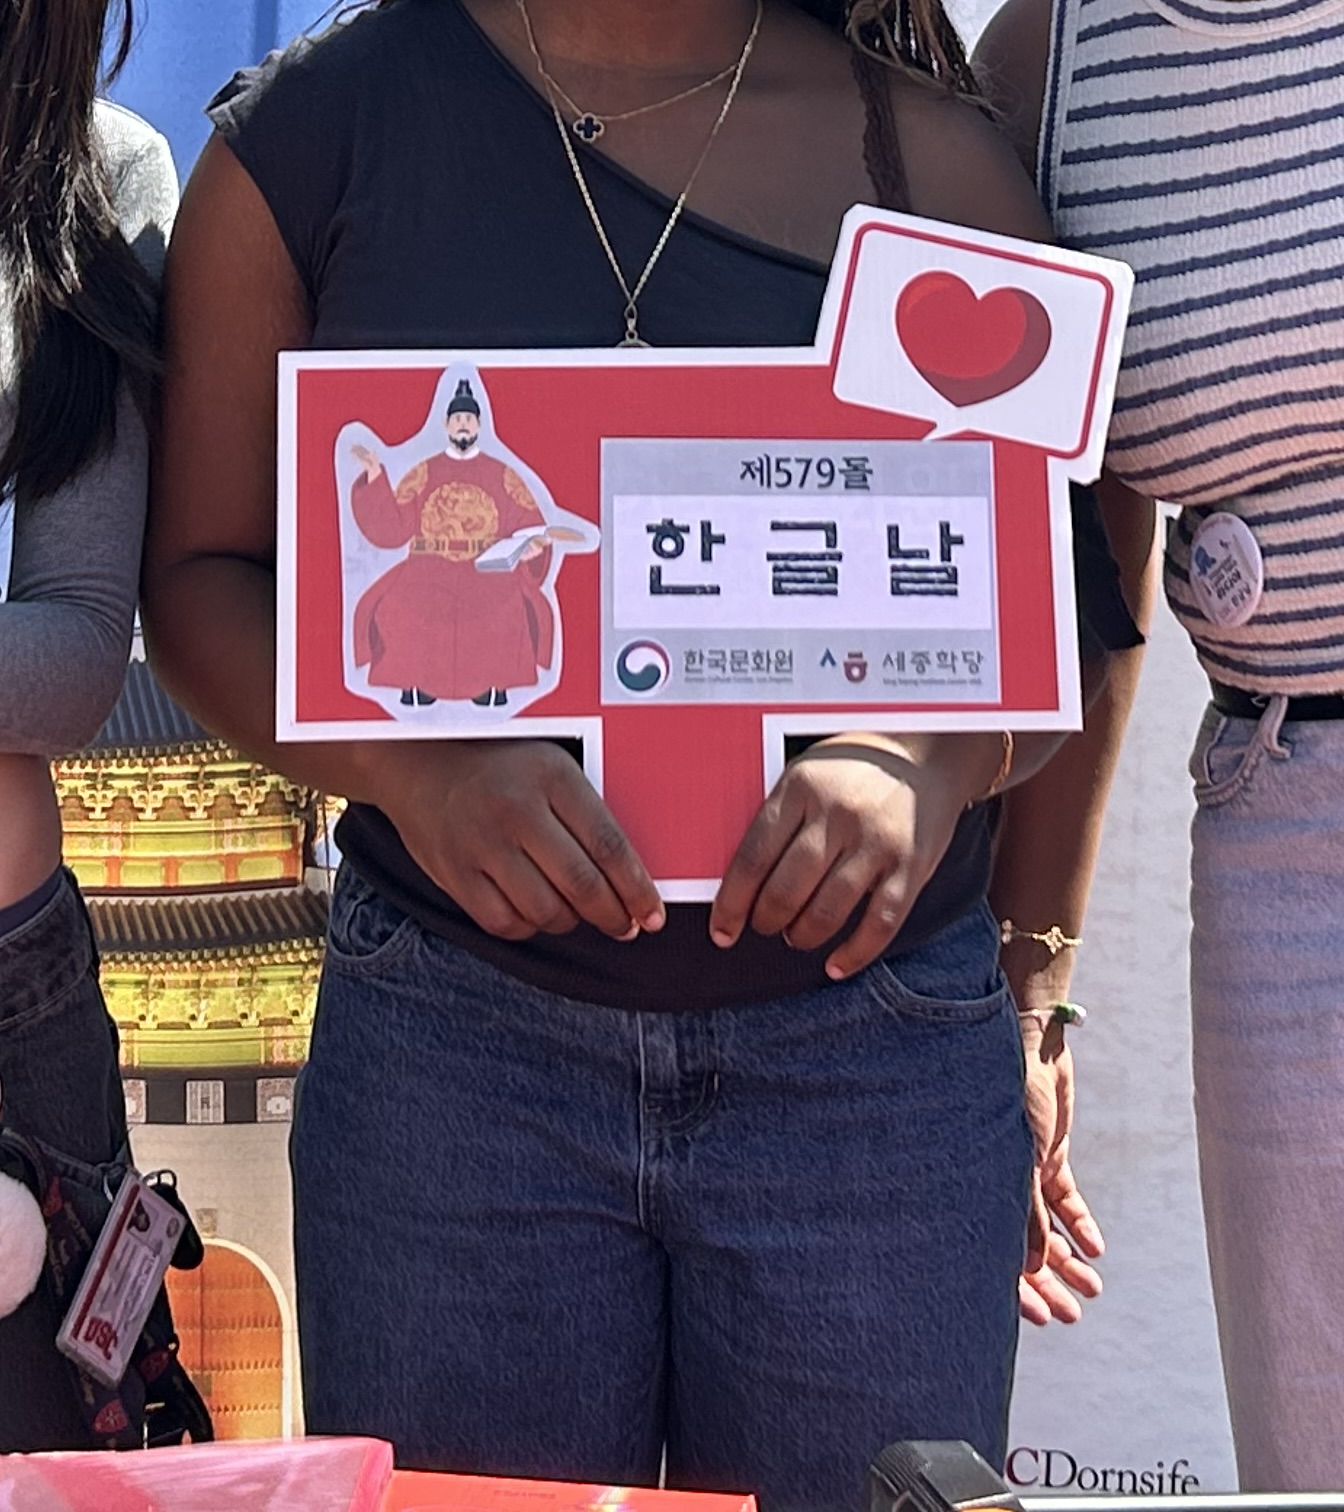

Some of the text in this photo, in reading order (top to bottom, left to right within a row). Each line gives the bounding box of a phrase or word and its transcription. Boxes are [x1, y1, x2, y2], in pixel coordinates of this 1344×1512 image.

[739, 453, 874, 491] 제579돌
[683, 648, 794, 675] 한국문화원
[882, 648, 986, 676] 세종학당
[1005, 1447, 1200, 1494] CDornsife
